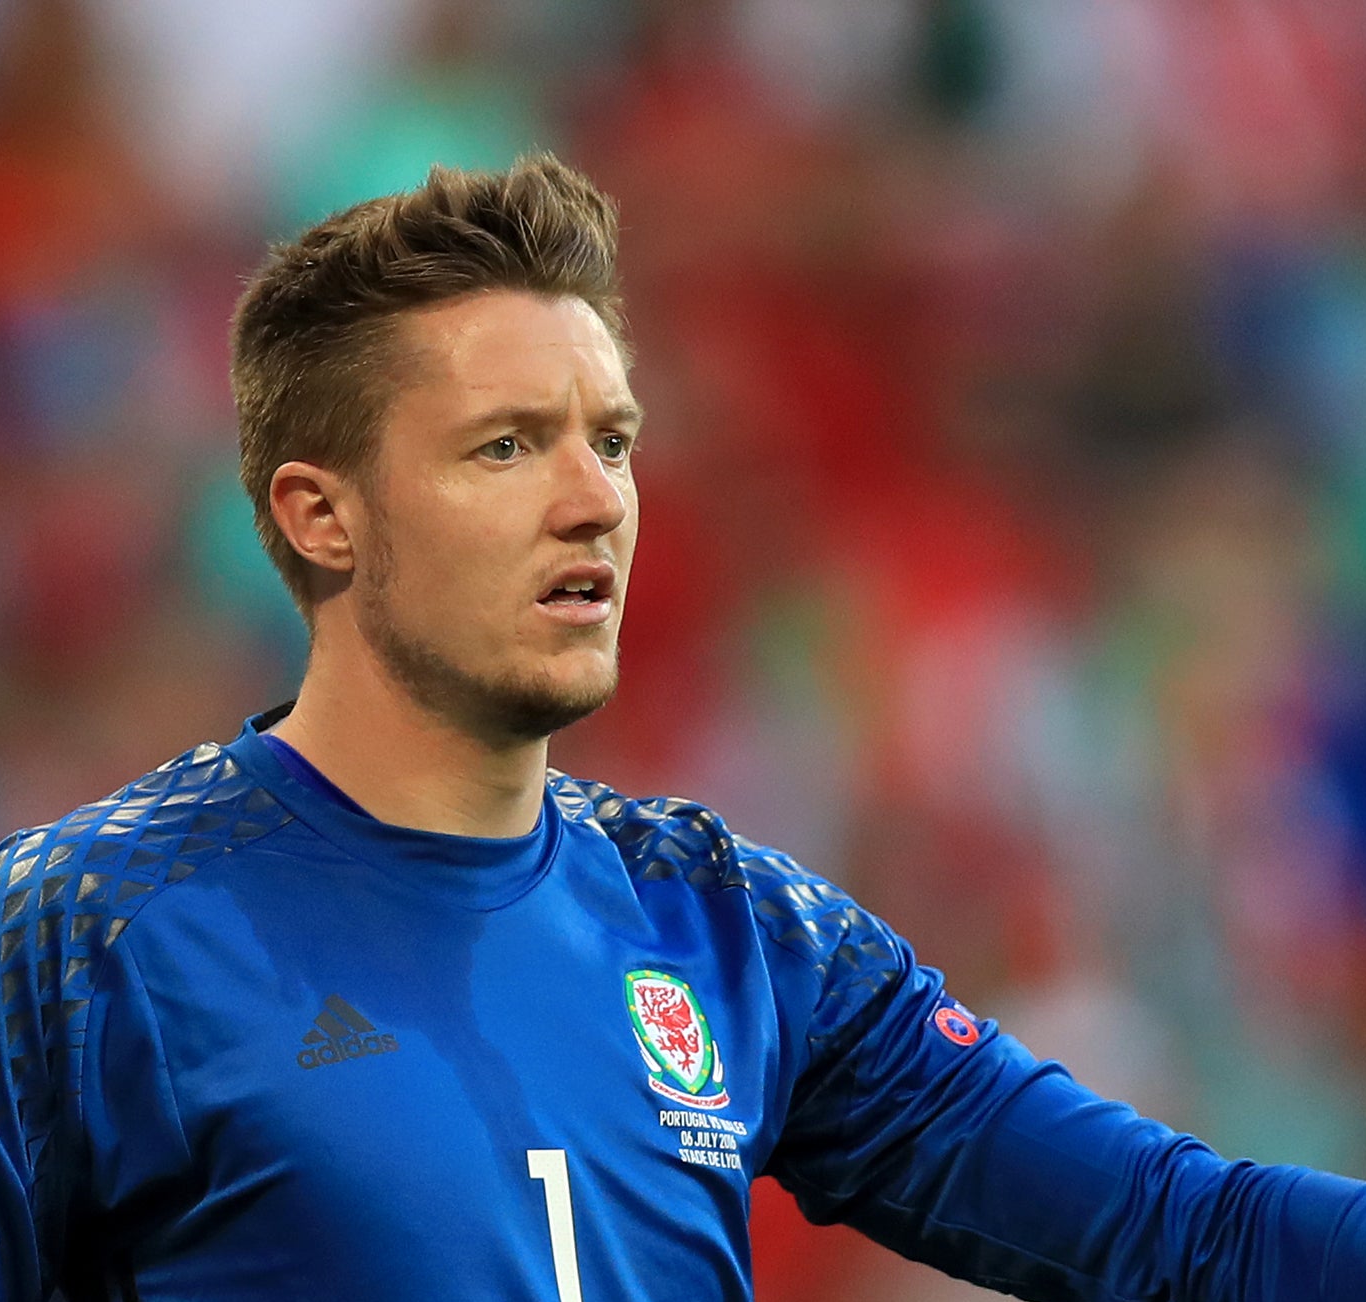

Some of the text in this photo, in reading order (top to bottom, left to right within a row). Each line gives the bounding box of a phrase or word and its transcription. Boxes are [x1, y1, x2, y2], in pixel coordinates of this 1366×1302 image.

[297, 1033, 400, 1070] adidas
[659, 1110, 711, 1129] PORTUGAL
[680, 1130, 694, 1147] 06
[694, 1131, 719, 1148] JULY
[678, 1148, 709, 1166] STADE
[706, 1151, 721, 1168] DE
